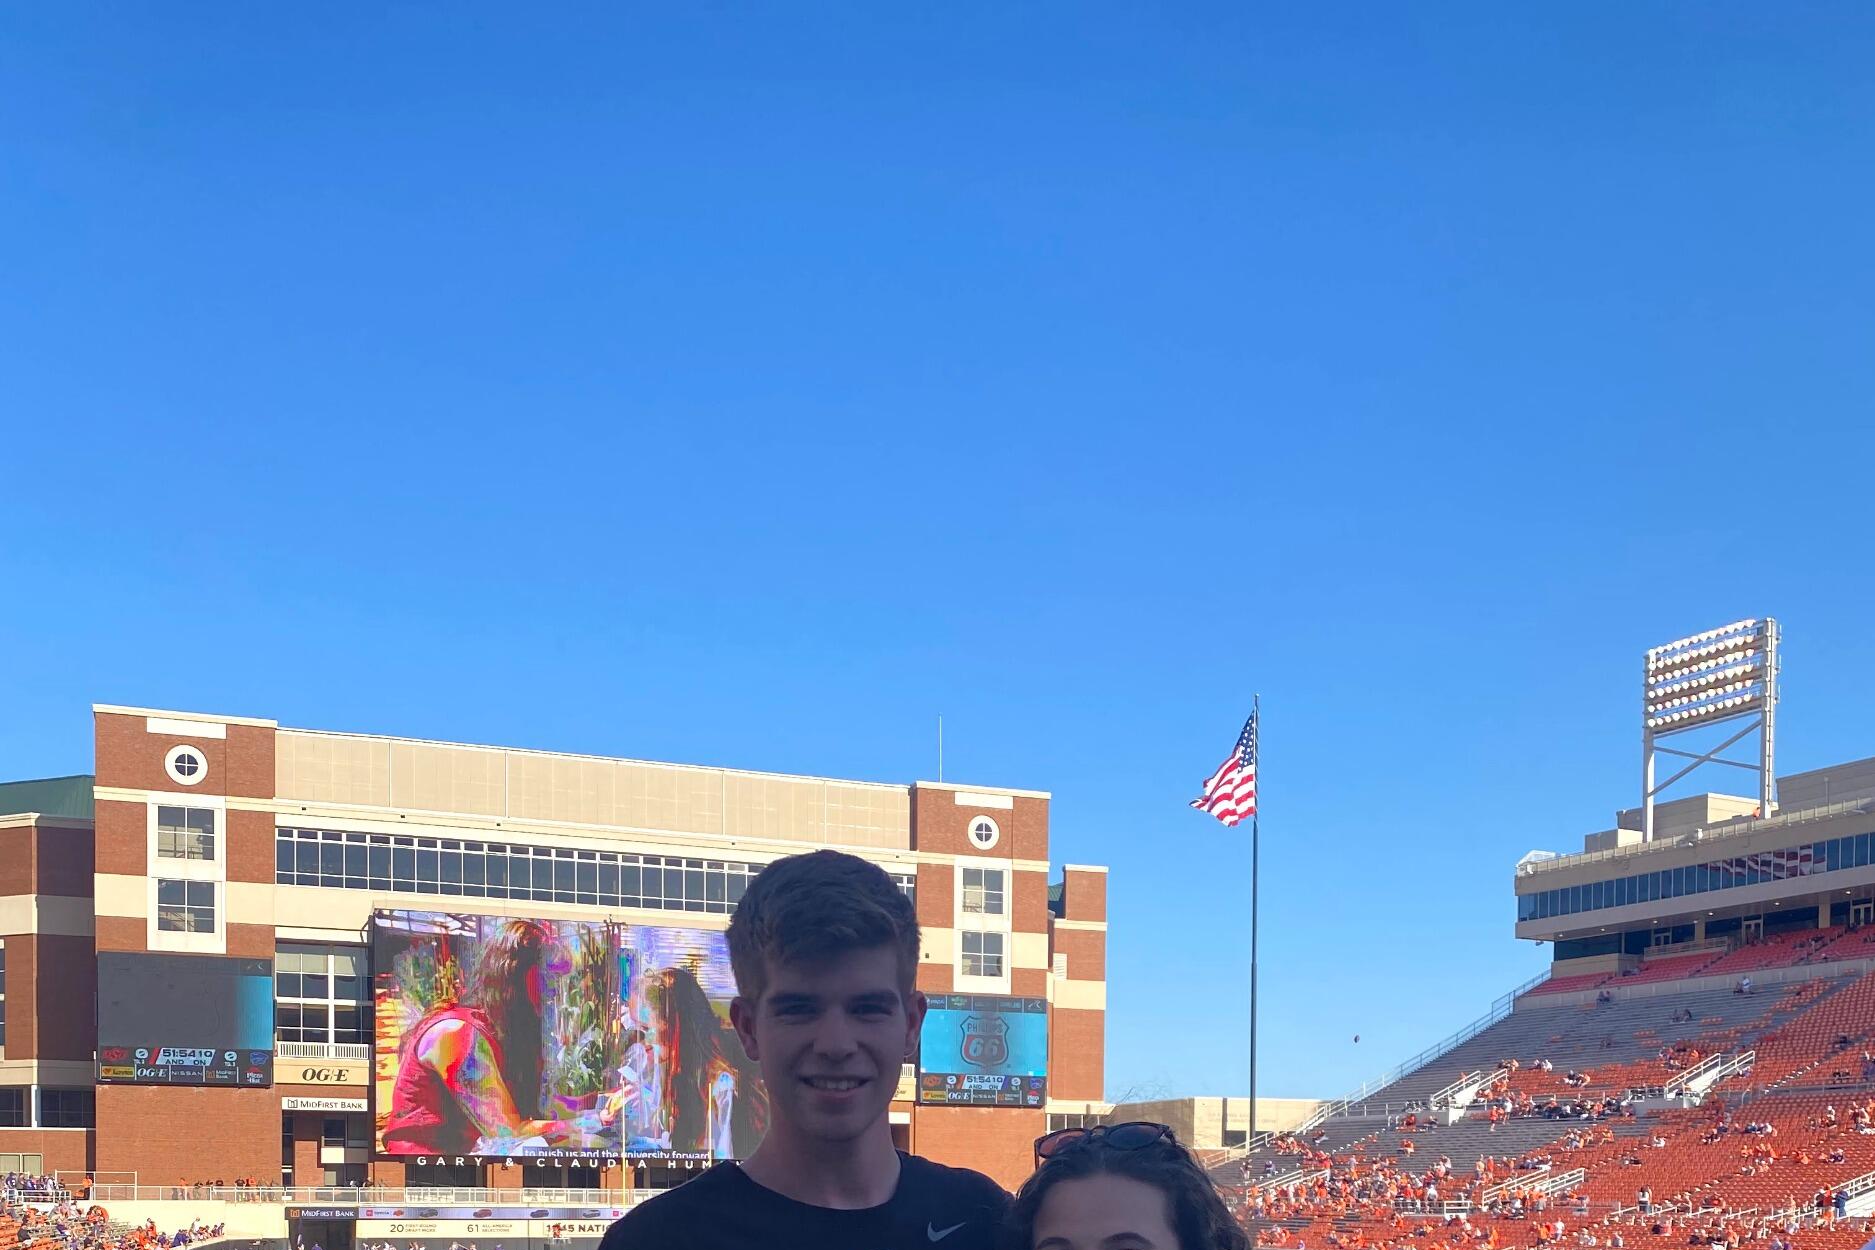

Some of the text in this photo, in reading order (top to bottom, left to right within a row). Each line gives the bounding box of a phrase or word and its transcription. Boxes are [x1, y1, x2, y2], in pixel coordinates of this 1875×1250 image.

[579, 1149, 600, 1158] and
[601, 1149, 619, 1158] the
[416, 1156, 483, 1166] GARY
[536, 1157, 647, 1169] CLAUDIA
[390, 1223, 405, 1233] 20
[467, 1224, 479, 1233] 61
